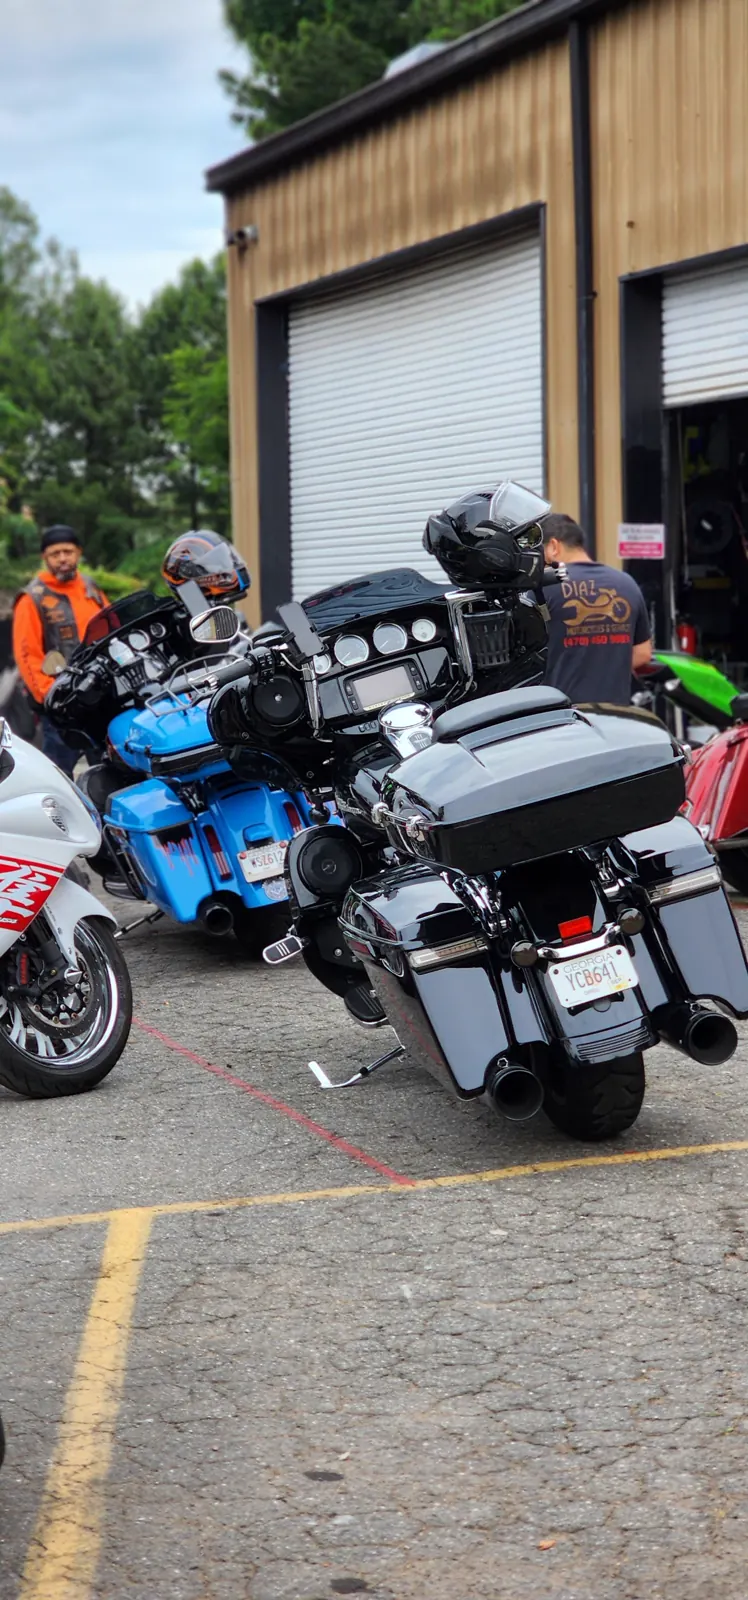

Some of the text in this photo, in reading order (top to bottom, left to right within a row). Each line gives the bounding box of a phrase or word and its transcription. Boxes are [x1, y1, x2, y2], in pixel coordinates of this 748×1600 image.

[561, 580, 597, 599] DIAZ
[563, 952, 614, 974] GEORGIA
[565, 961, 618, 991] YCB641
